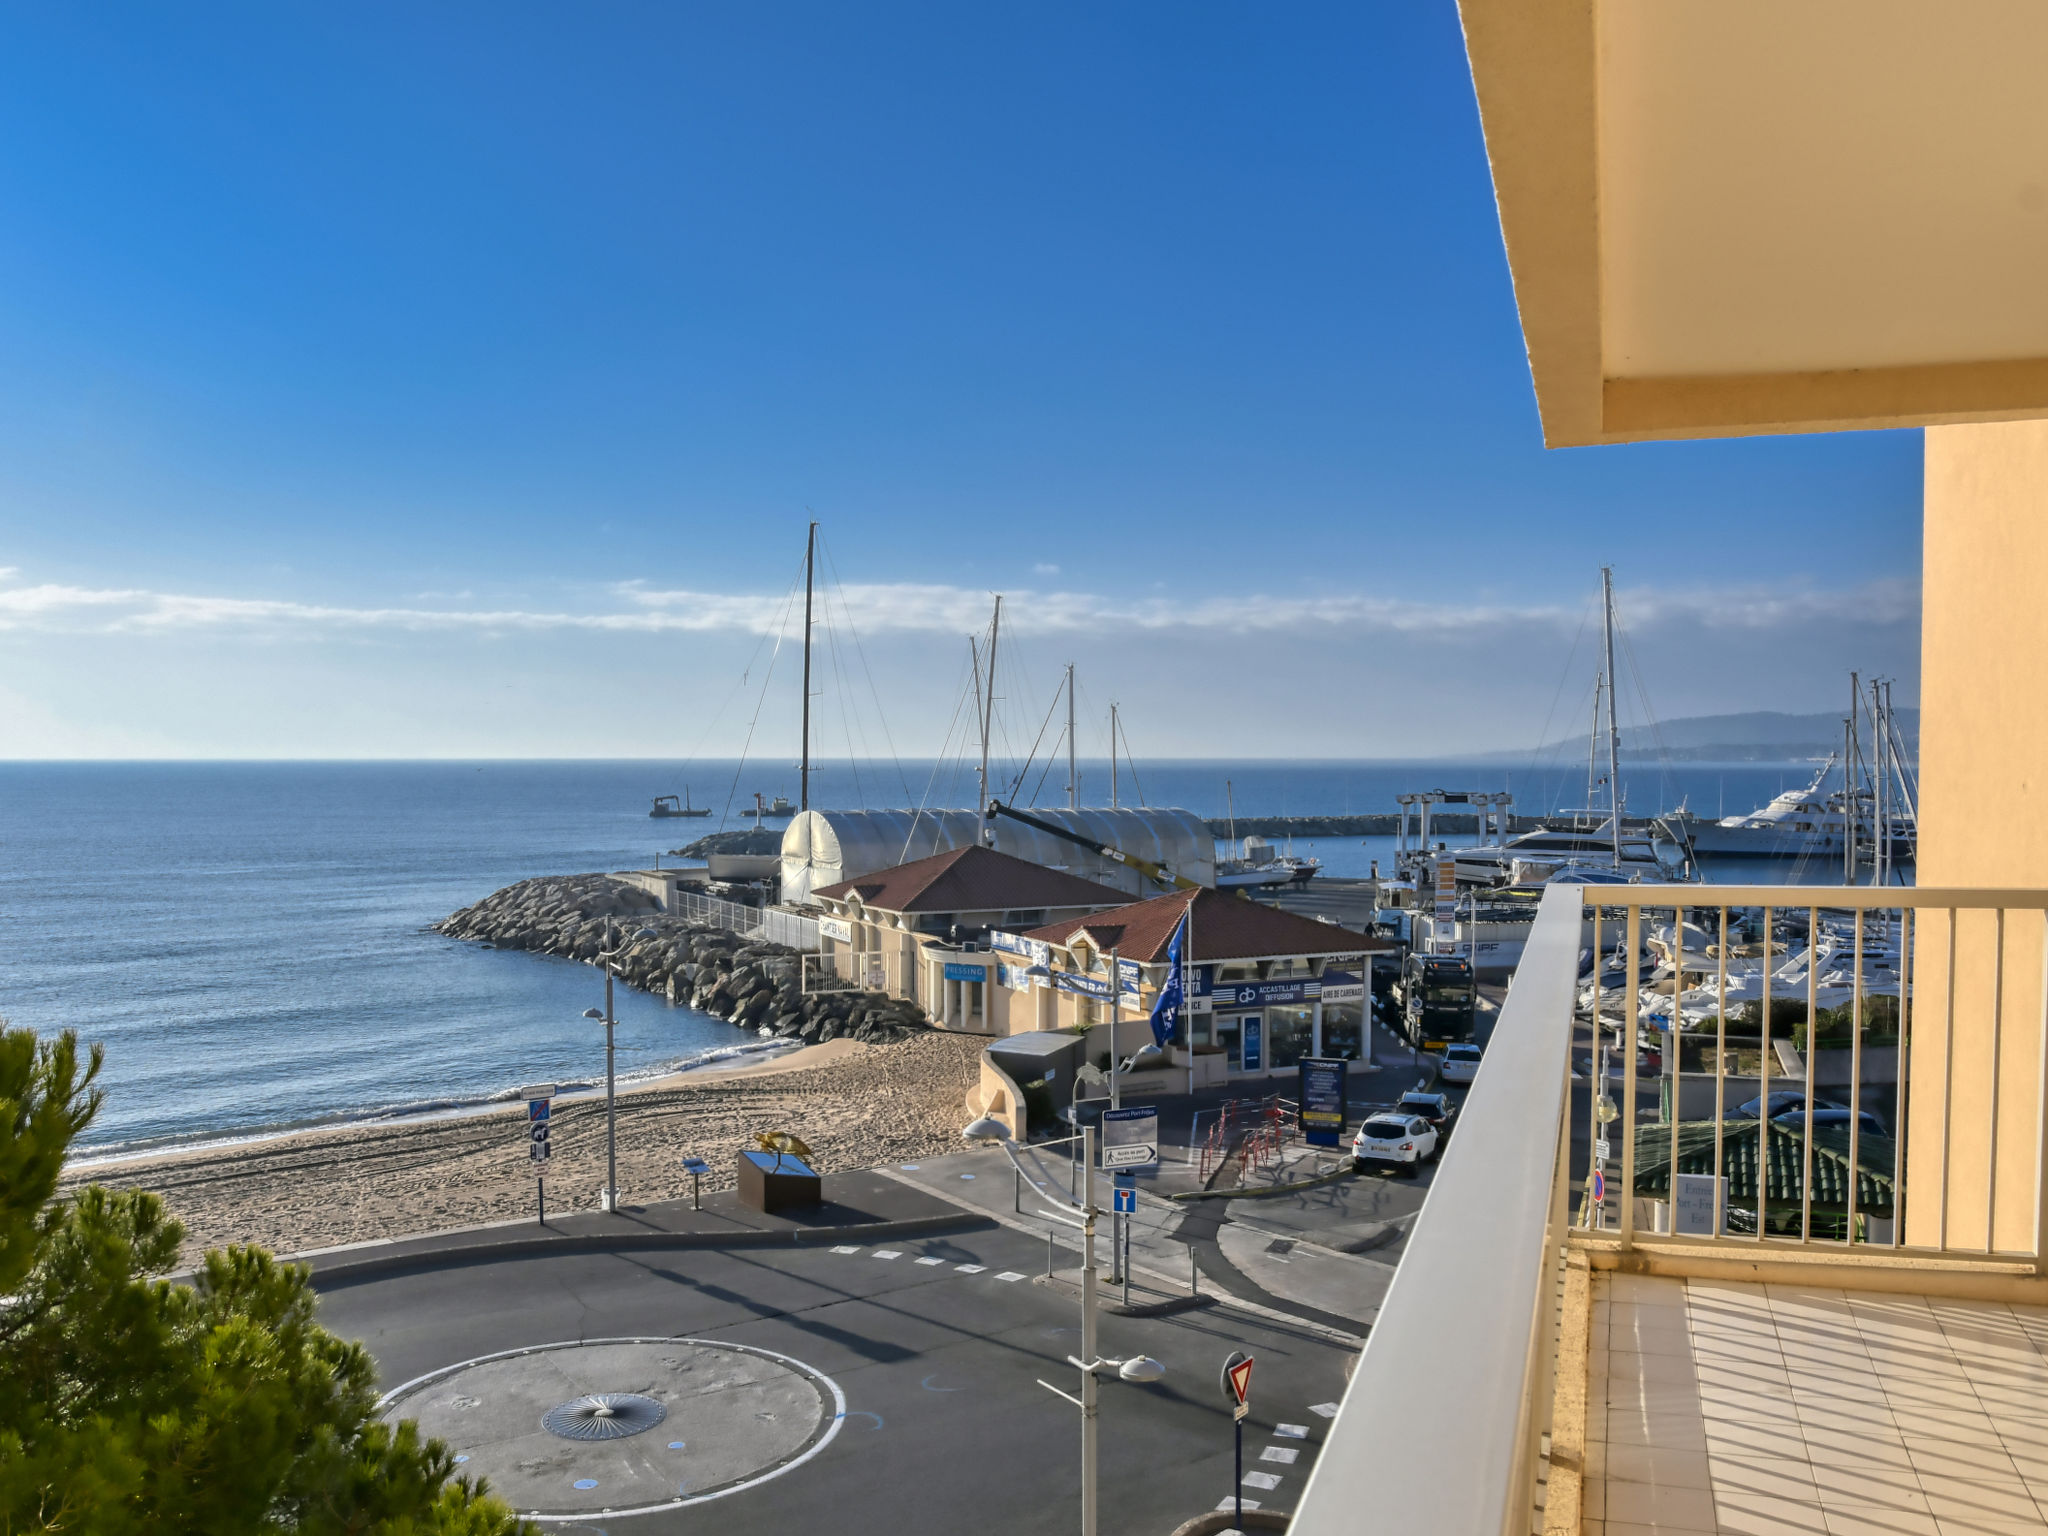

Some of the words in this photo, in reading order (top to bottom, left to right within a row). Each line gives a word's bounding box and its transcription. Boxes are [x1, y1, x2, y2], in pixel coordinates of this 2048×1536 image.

[946, 965, 983, 976] PRESSING
[1259, 984, 1301, 994] ACCASTILLAGE
[1265, 992, 1294, 1001] DIFFUSION
